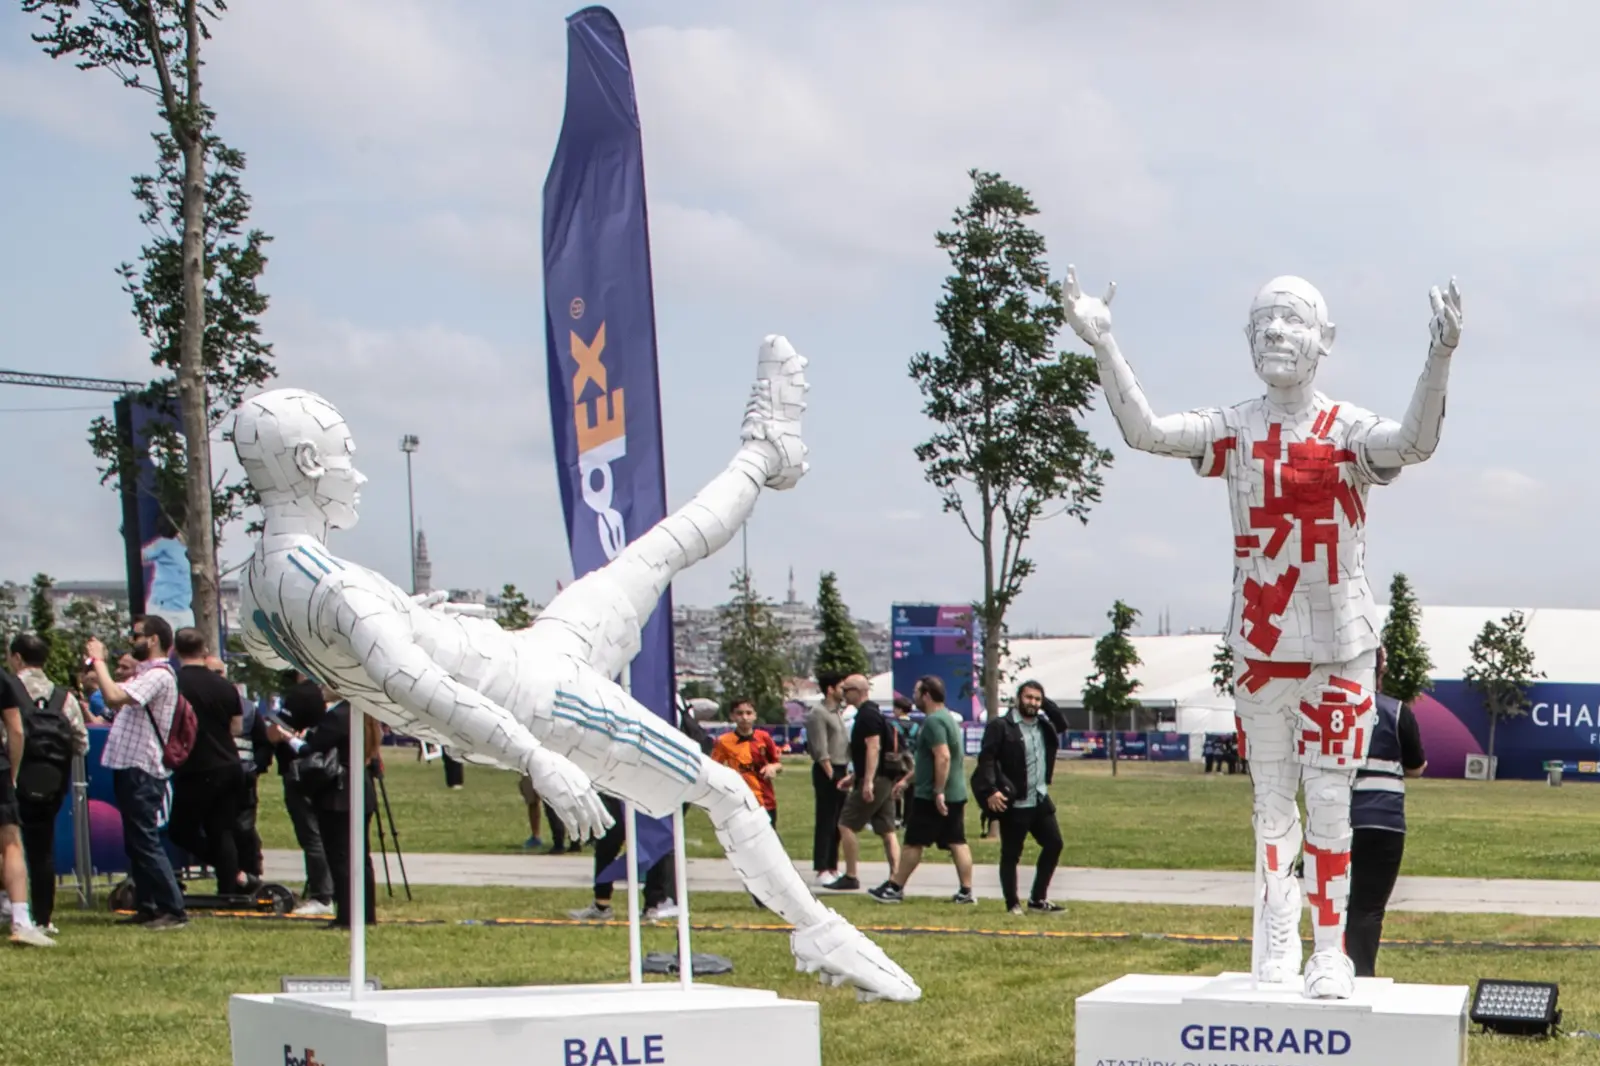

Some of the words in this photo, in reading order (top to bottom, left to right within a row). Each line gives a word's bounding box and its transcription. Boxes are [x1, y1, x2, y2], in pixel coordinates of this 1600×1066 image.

[570, 319, 627, 561] edEx
[1331, 709, 1344, 733] 8
[1179, 1023, 1352, 1056] GERRARD
